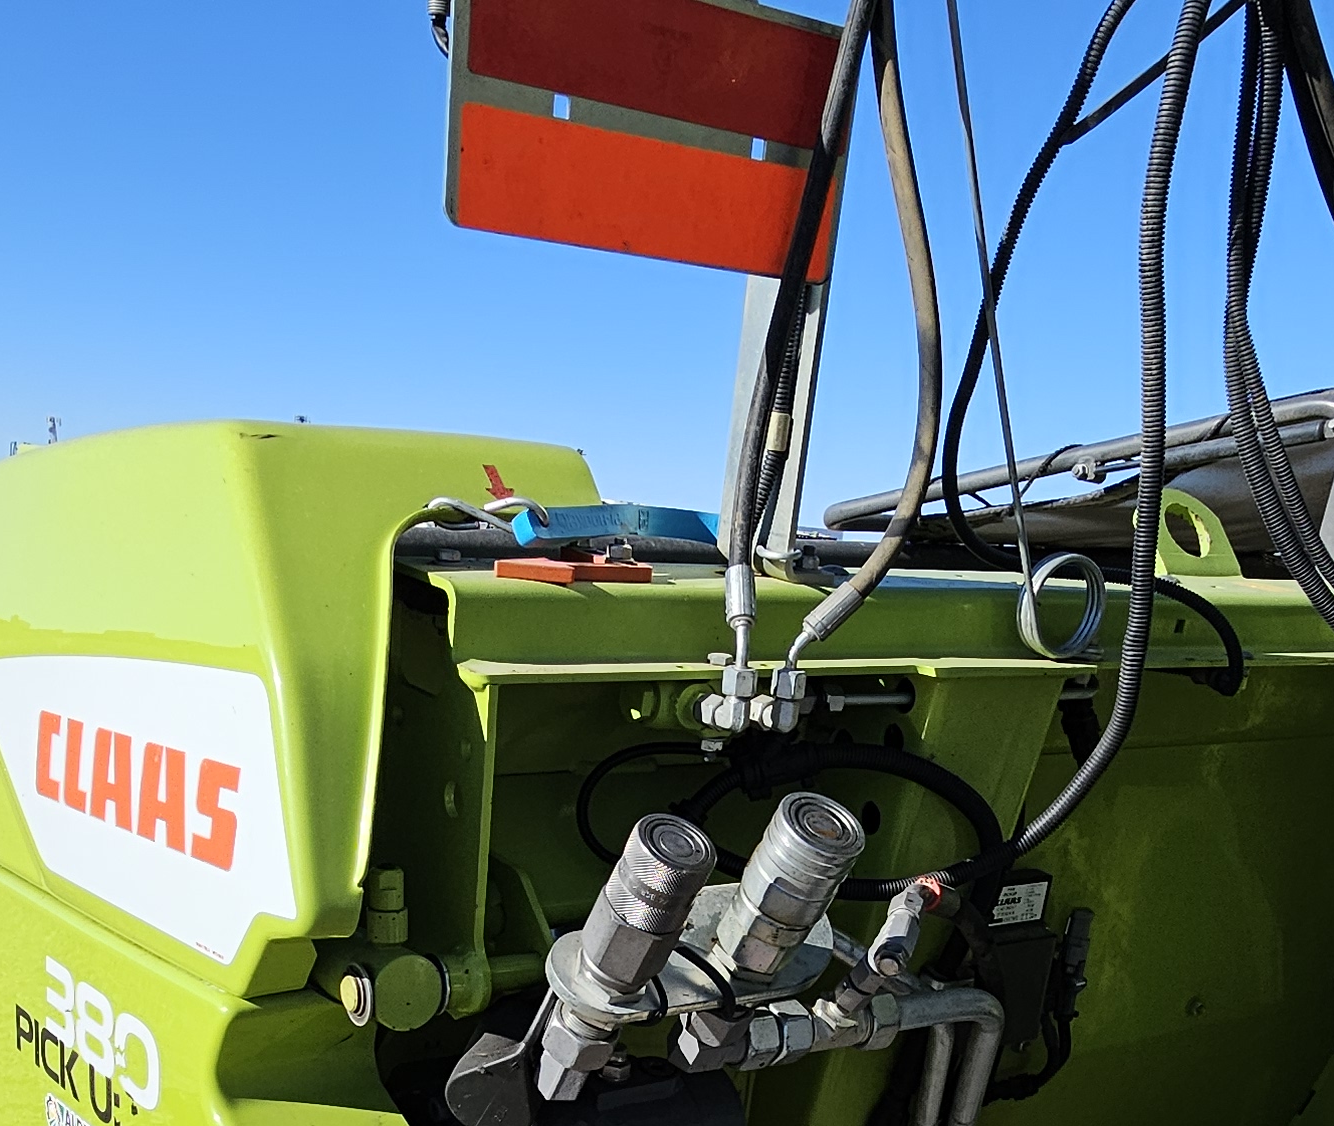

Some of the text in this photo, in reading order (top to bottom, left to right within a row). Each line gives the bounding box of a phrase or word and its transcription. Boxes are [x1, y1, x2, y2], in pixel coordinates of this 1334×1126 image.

[36, 710, 242, 872] CLAAS
[16, 1003, 80, 1102] PICK
[45, 955, 161, 1110] 380
